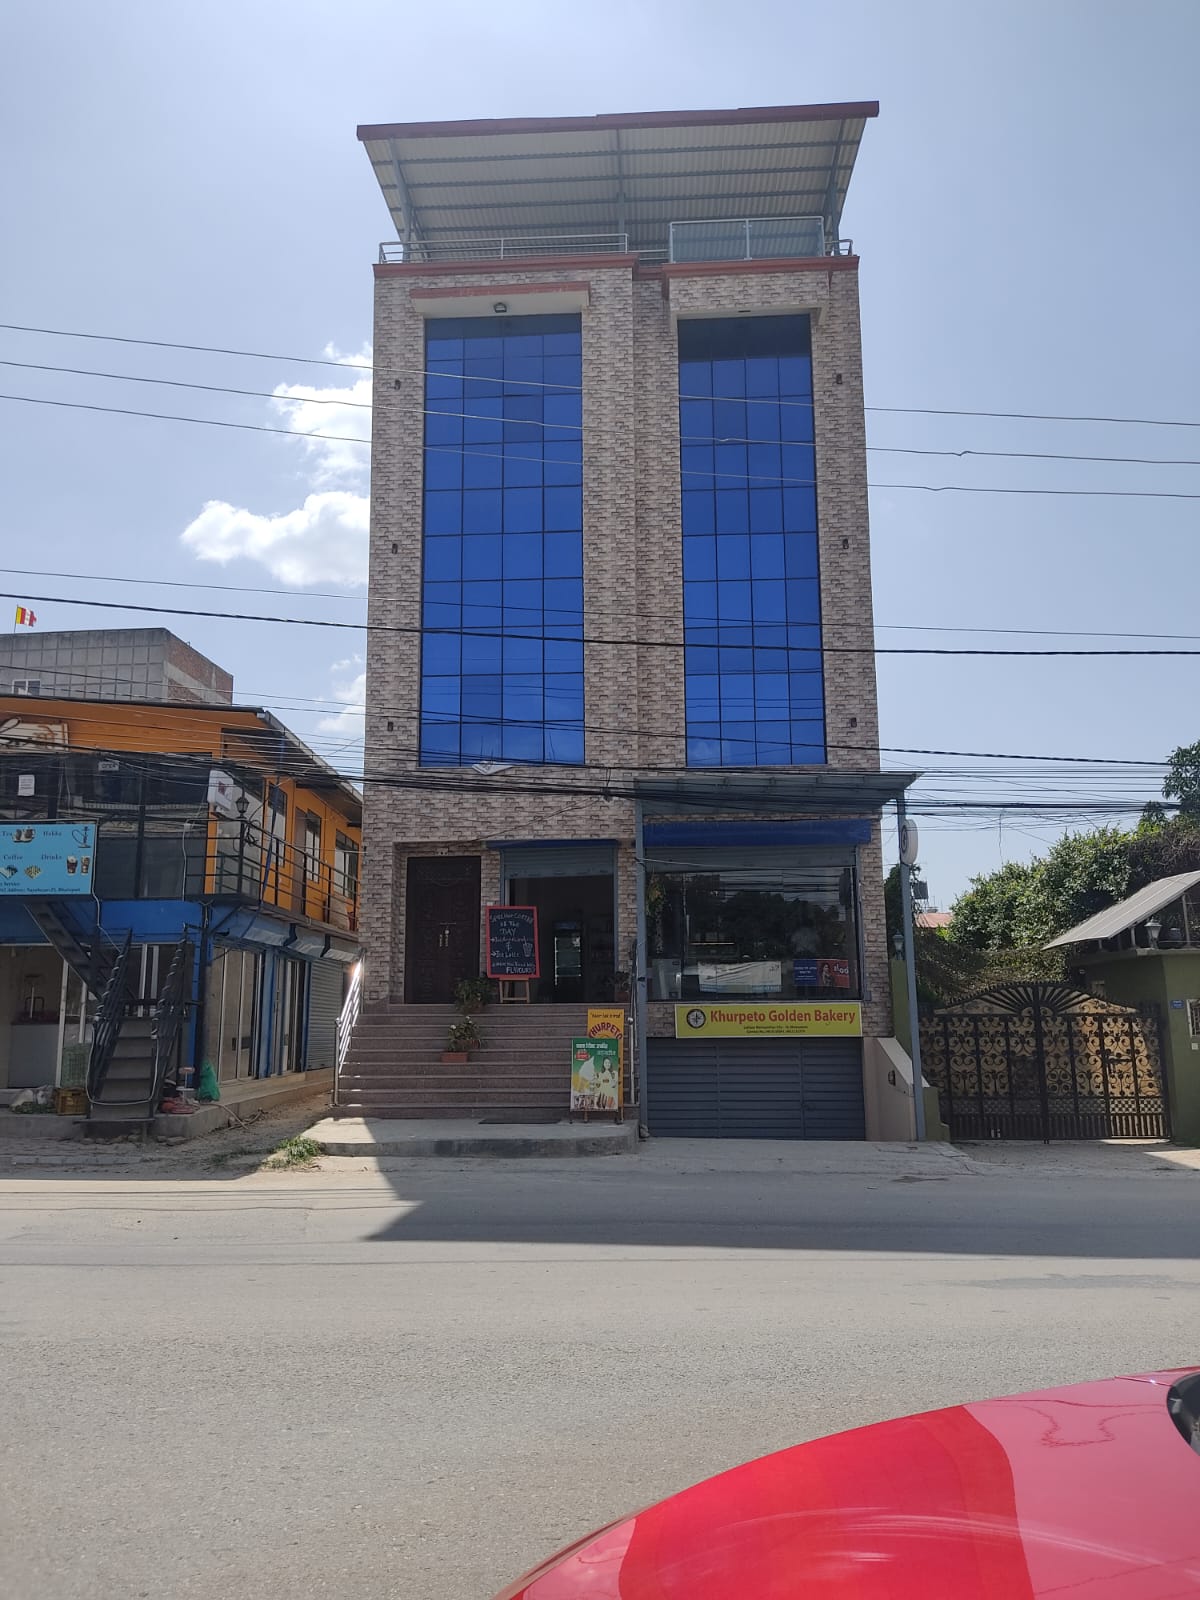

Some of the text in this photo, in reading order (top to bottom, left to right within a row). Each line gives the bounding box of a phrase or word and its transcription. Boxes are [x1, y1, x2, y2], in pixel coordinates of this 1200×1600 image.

[710, 1009, 856, 1024] Khurpeto Golden Bakery
